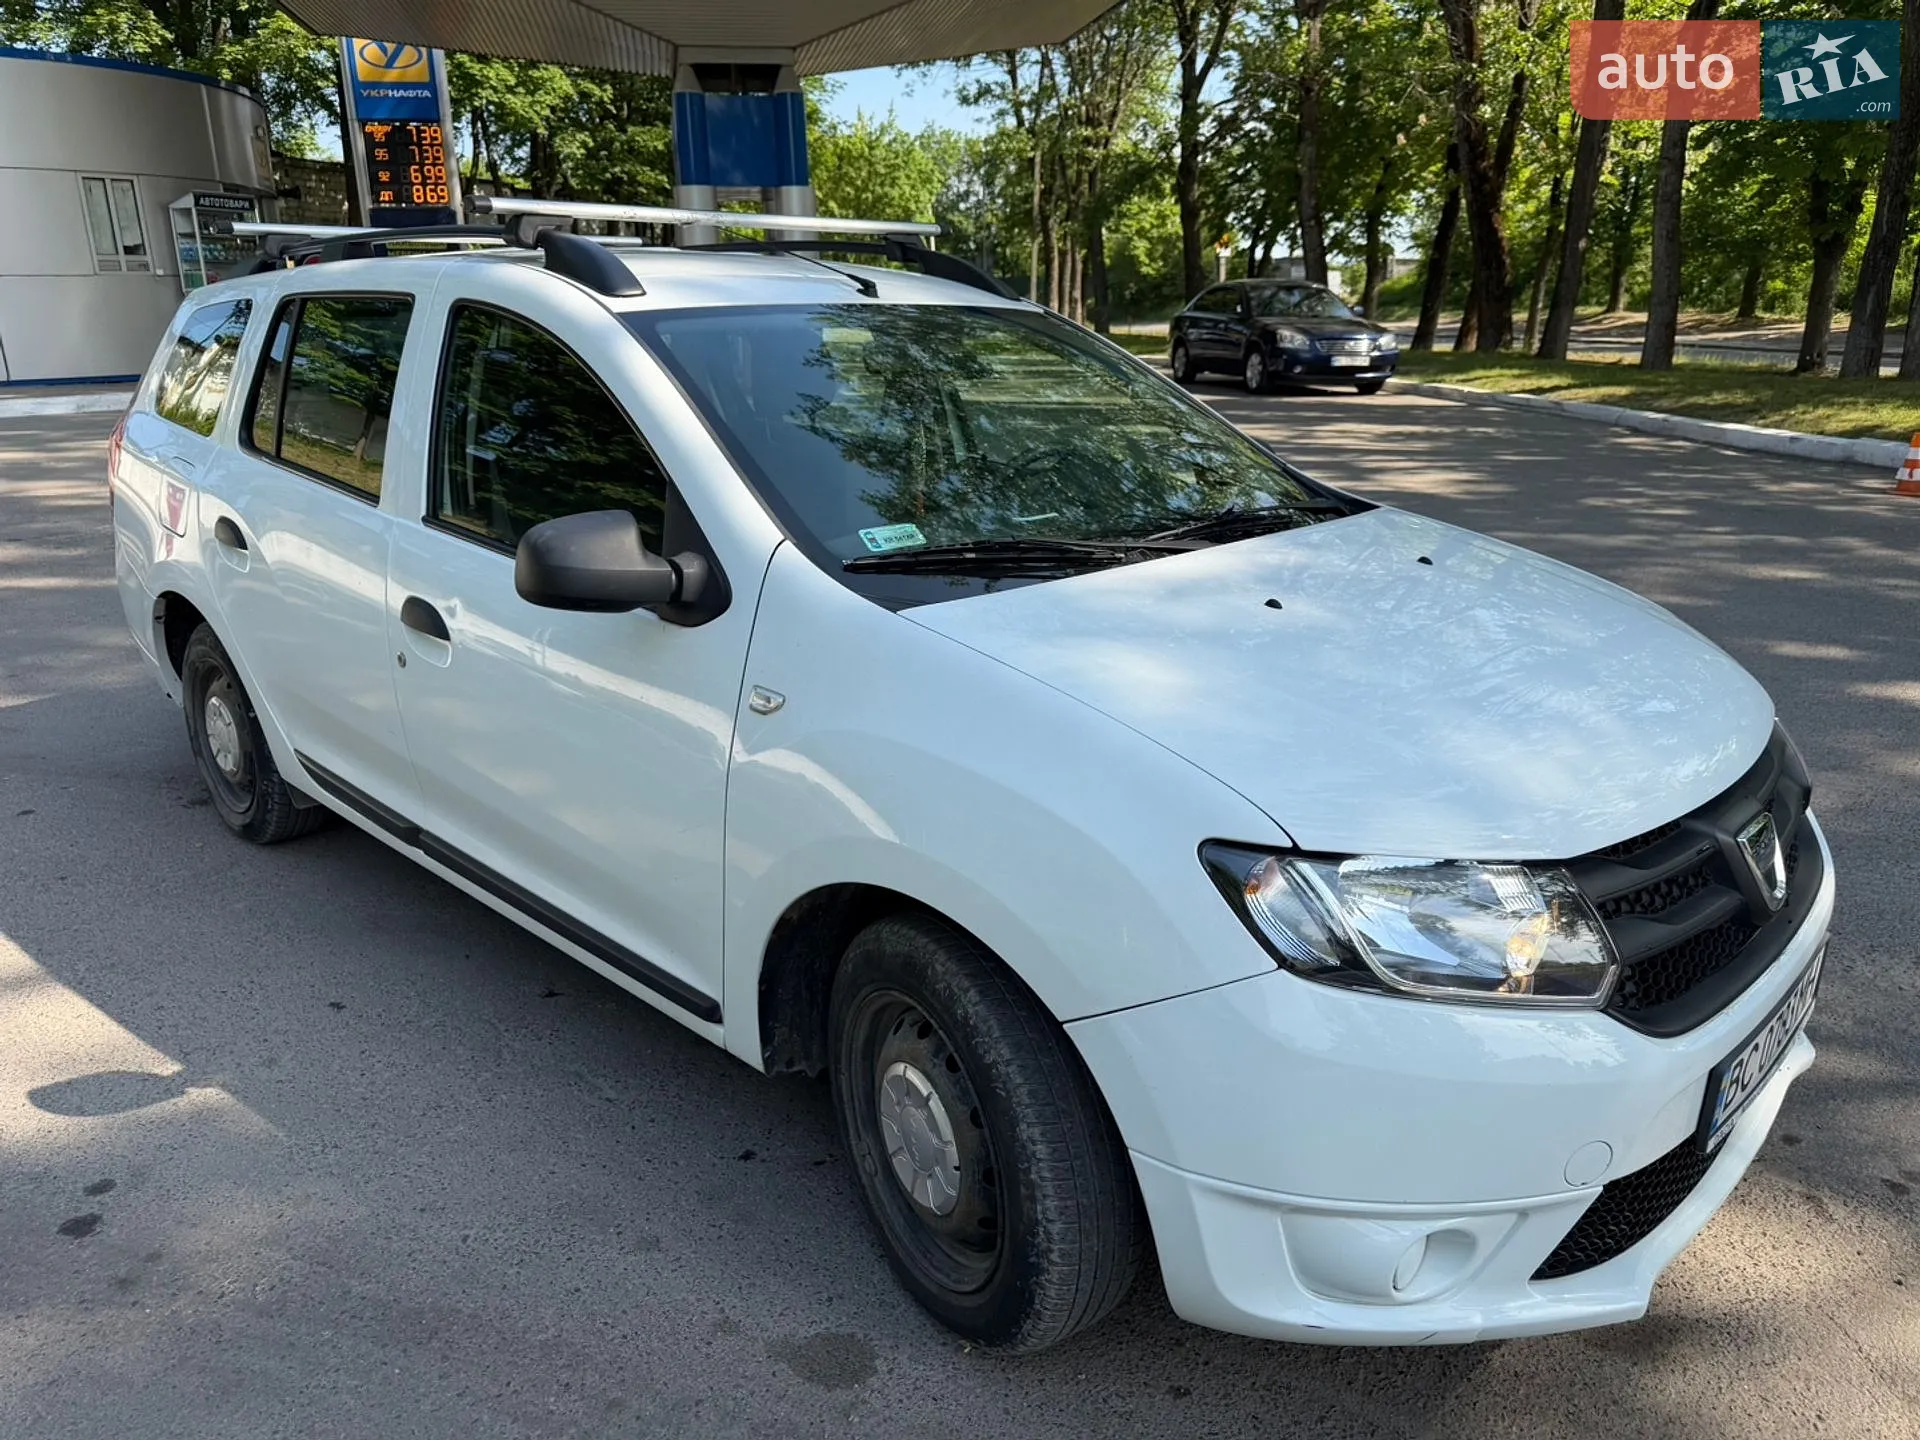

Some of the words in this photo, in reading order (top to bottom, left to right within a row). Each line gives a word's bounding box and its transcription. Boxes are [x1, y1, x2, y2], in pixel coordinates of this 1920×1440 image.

[360, 88, 432, 98] УКРНАФТА
[406, 126, 442, 144] 739
[374, 147, 390, 161] 95
[408, 145, 445, 163] 739
[377, 170, 391, 182] 92
[410, 165, 447, 183] 699
[199, 196, 250, 209] АВТОТОВАРИ
[412, 185, 449, 203] 869
[1723, 1042, 1759, 1112] BC
